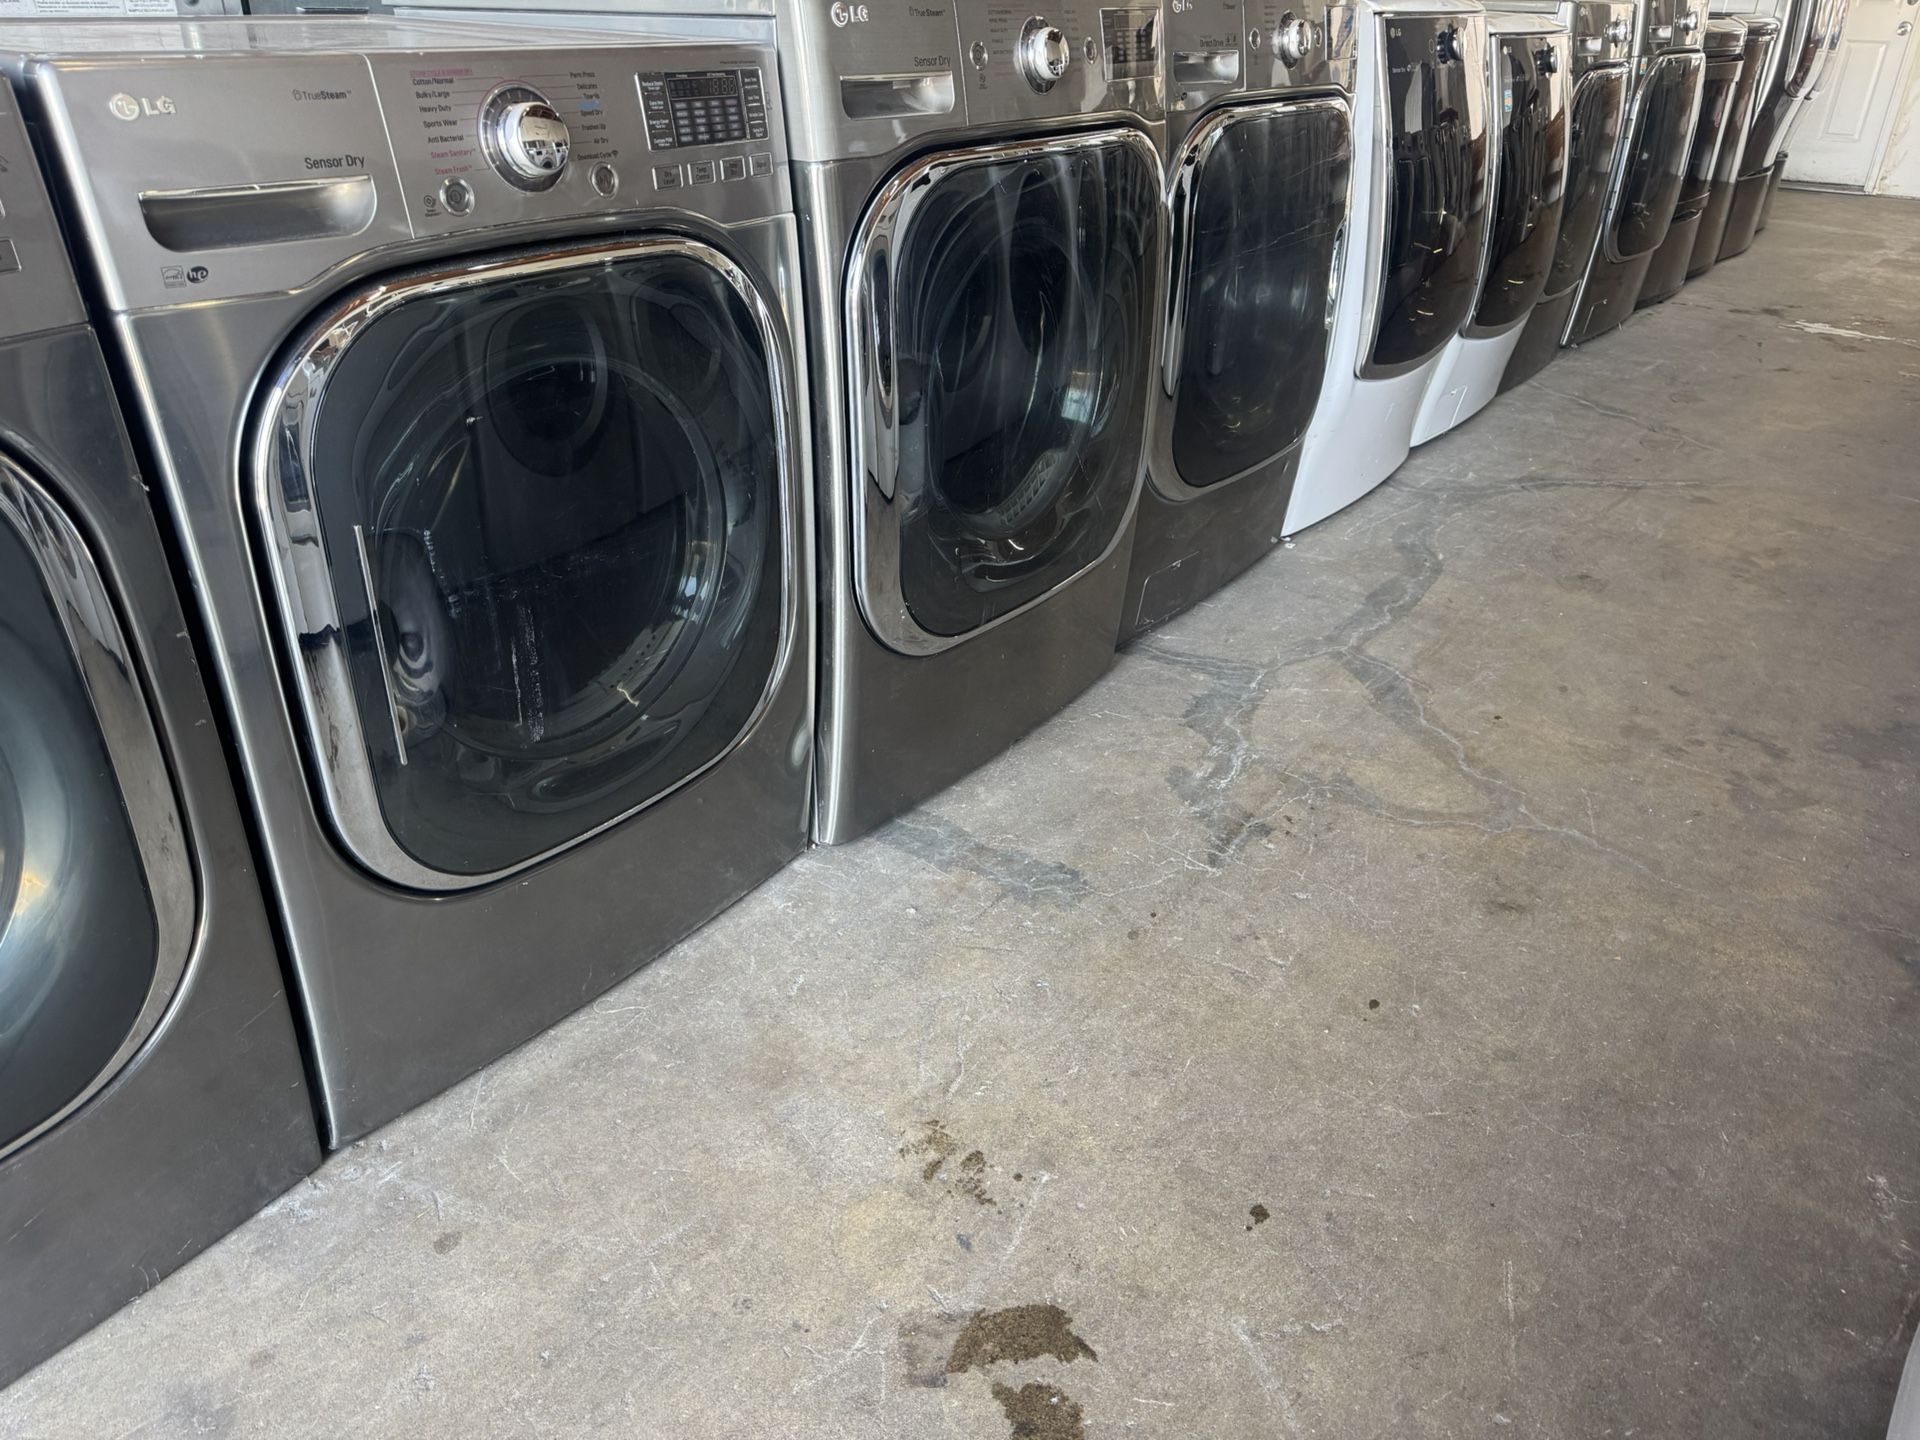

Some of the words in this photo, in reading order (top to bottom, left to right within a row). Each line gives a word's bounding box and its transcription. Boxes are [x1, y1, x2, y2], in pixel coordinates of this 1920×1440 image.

[914, 56, 938, 67] Sensor
[938, 55, 951, 67] Dry
[419, 105, 438, 114] Heavy
[438, 104, 452, 112] Duty
[423, 121, 443, 129] Sports
[443, 119, 458, 127] Wear
[304, 157, 343, 170] Sensor
[345, 154, 365, 169] Dry
